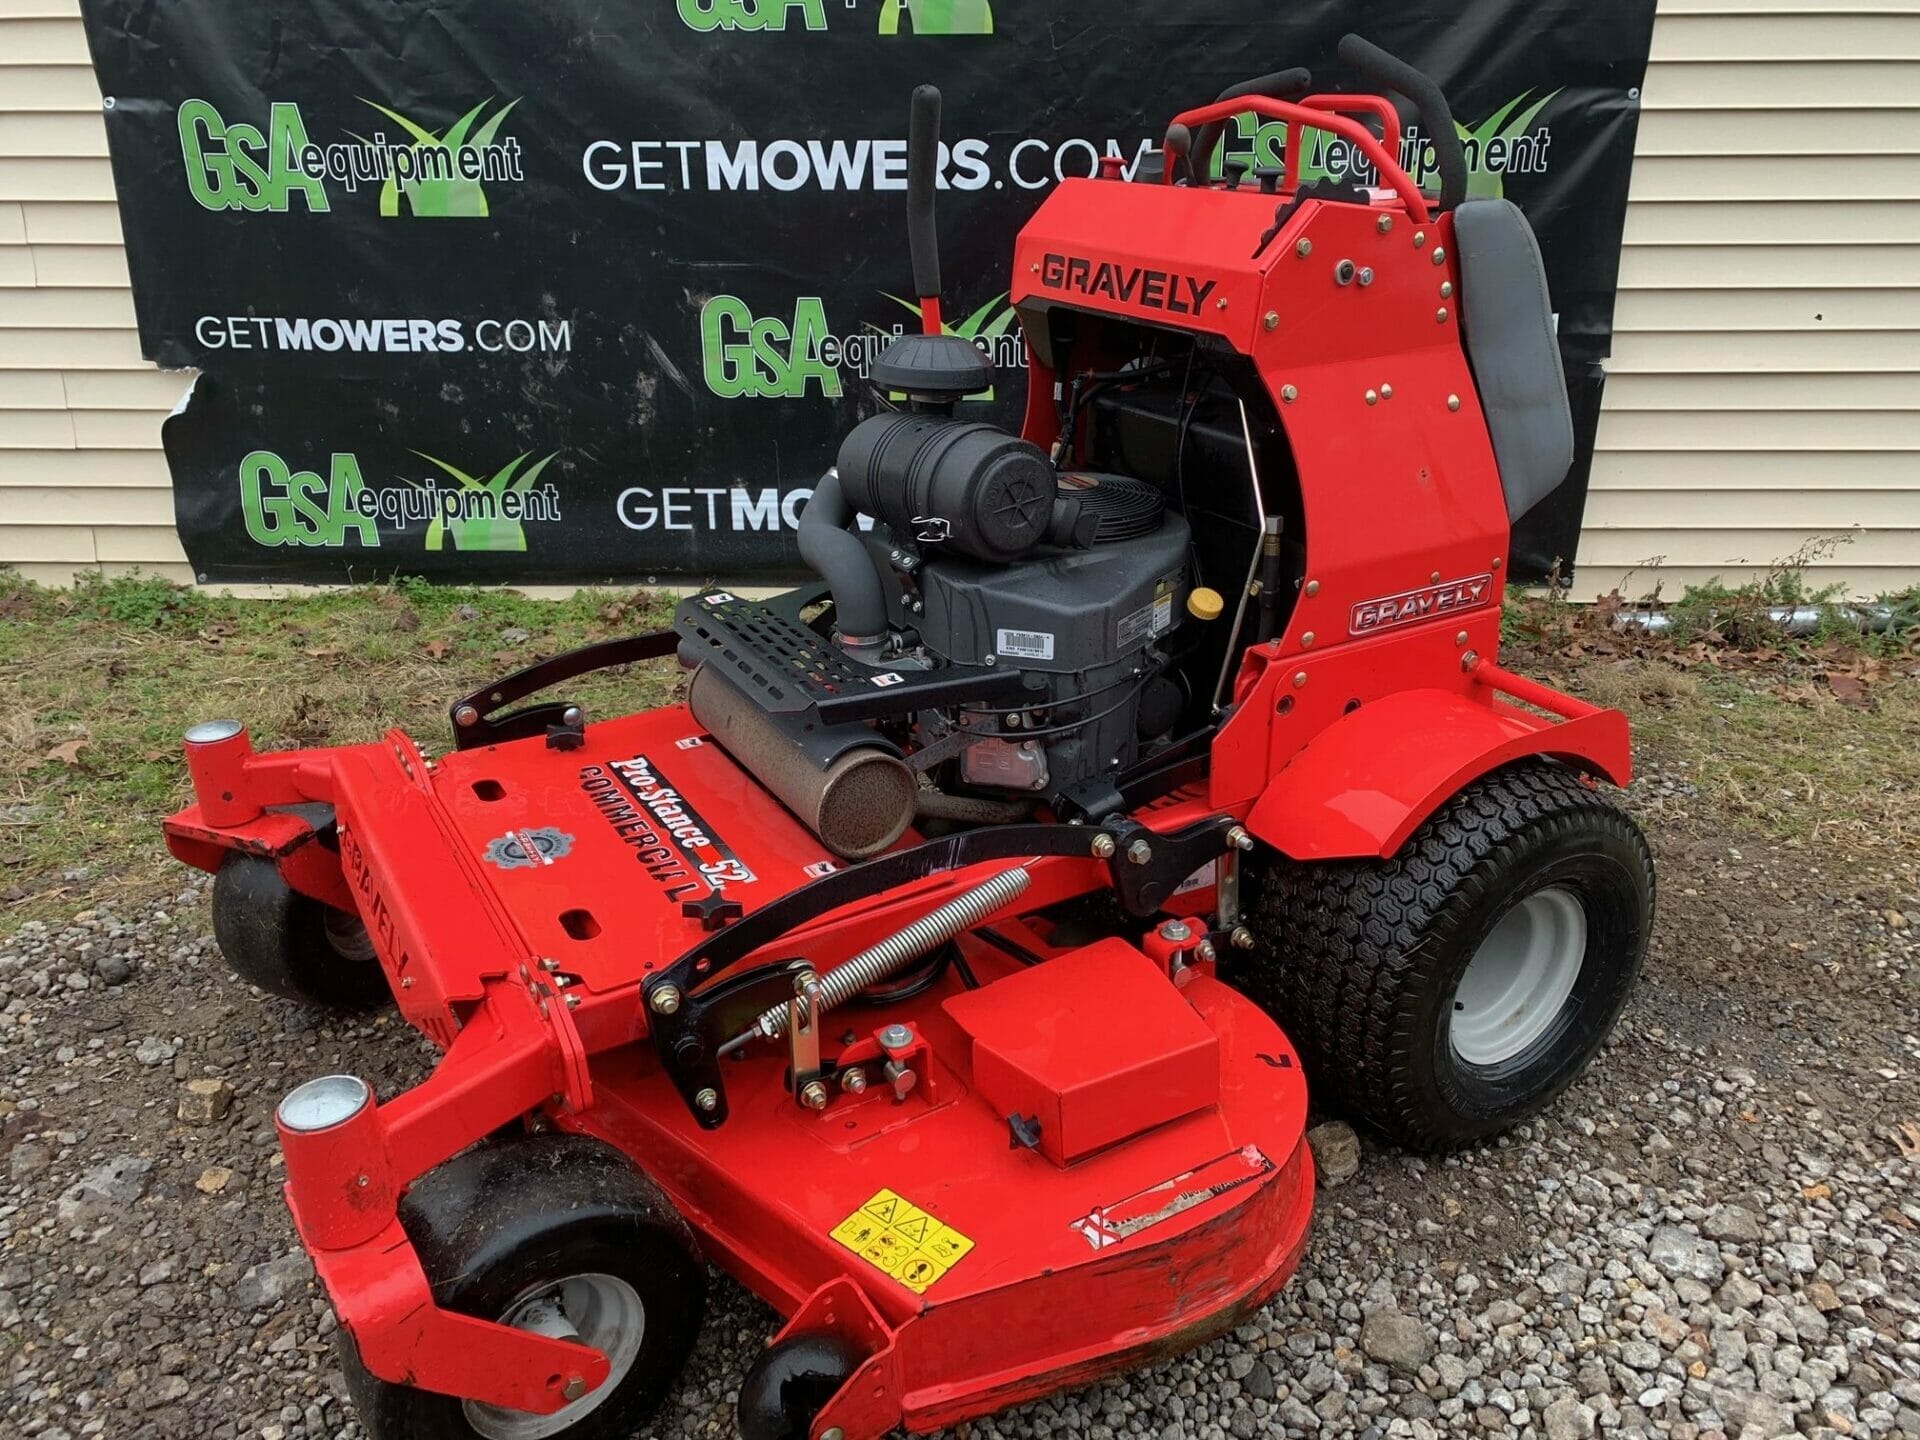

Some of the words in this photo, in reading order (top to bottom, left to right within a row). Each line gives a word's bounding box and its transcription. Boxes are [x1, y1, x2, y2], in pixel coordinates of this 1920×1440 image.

[1042, 253, 1217, 316] GRAVELY
[195, 316, 571, 352] GETMOWERS.COM
[1356, 579, 1488, 629] GRAVELY
